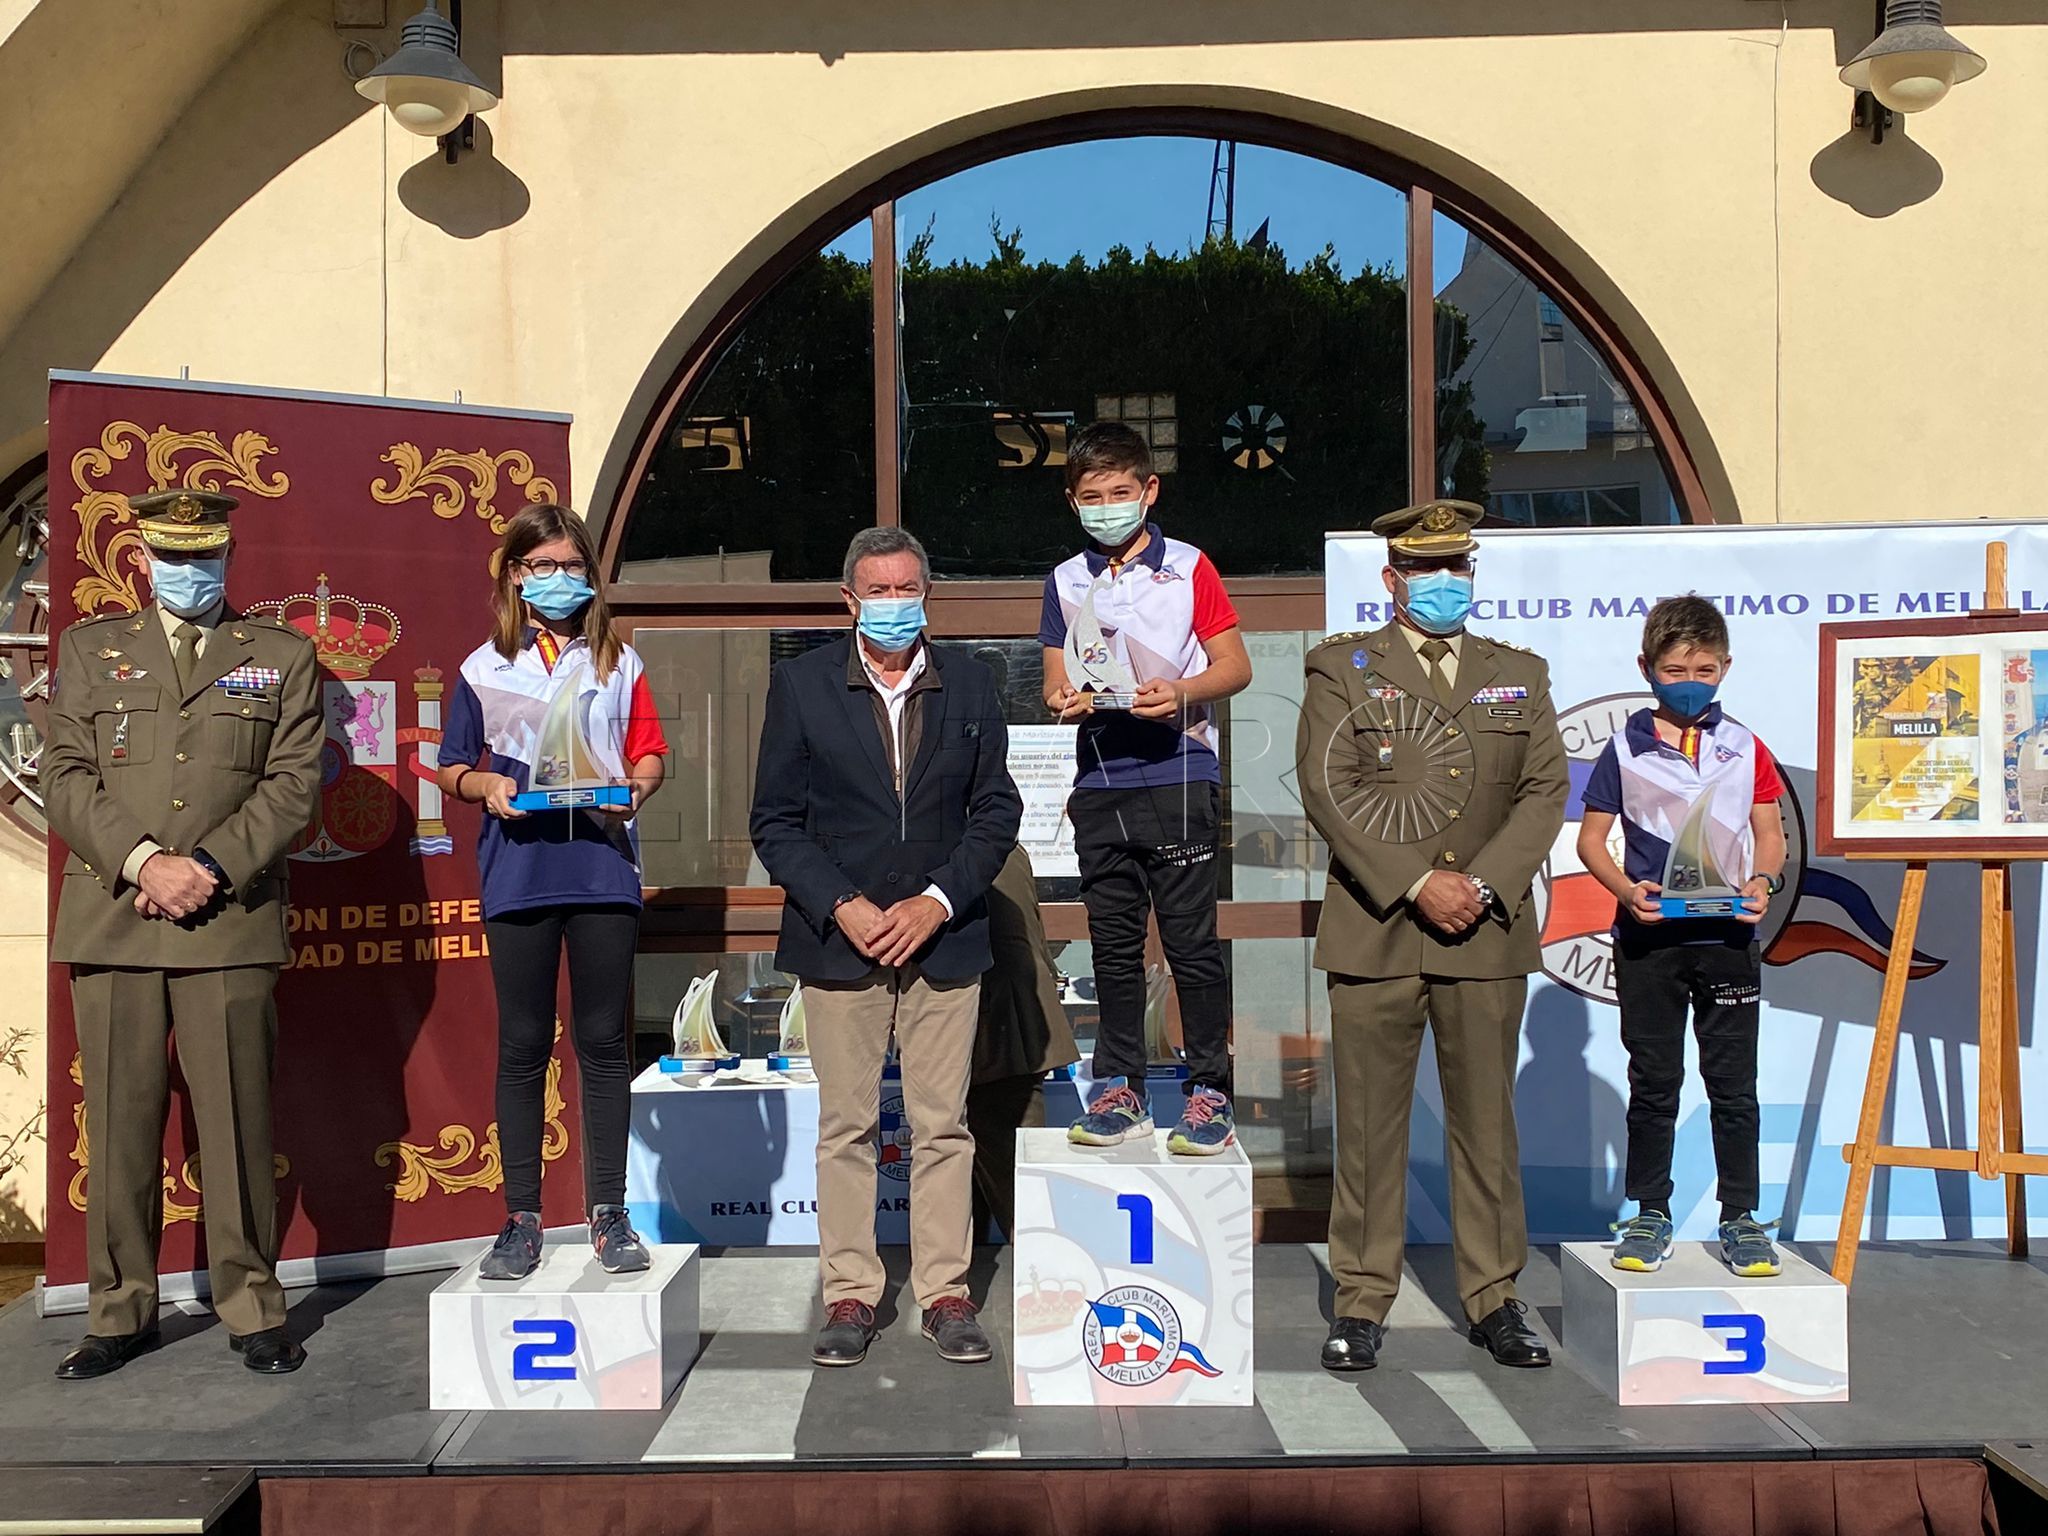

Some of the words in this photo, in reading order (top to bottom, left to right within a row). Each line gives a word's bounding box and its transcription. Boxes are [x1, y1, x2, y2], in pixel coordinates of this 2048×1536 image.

[1471, 598, 1572, 620] CLUB
[1588, 593, 1810, 618] MAIMO
[1827, 593, 1879, 614] DE
[1893, 723, 1938, 735] MELILLA
[341, 905, 387, 929] DE
[400, 899, 480, 927] DEFE
[357, 939, 403, 964] DE
[711, 1202, 771, 1216] REAL
[1117, 1194, 1153, 1264] 1
[1090, 1321, 1101, 1357] REAL
[1107, 1290, 1140, 1306] CLUB
[1142, 1292, 1177, 1352] MARITIMO
[513, 1320, 576, 1380] 2
[1703, 1314, 1766, 1374] 3
[1106, 1358, 1167, 1383] MELILLA
